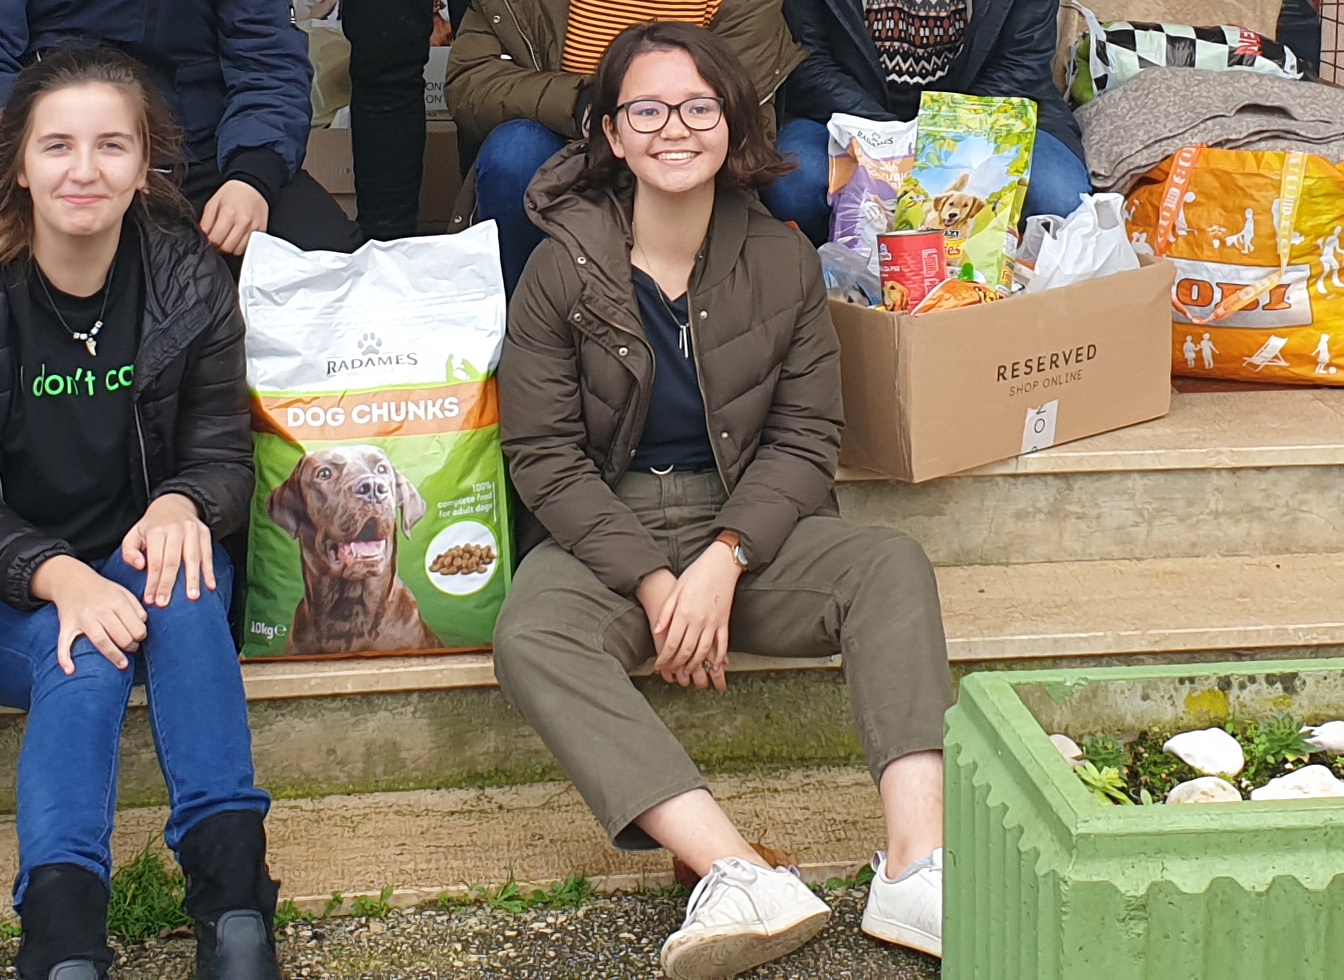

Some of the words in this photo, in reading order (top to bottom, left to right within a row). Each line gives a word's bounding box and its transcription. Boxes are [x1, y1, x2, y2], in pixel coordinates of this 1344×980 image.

[326, 352, 418, 376] RADAMES
[996, 343, 1097, 383] RESERVED
[32, 363, 96, 397] don't
[1009, 380, 1039, 397] SHOP
[1042, 369, 1084, 389] ONLINE
[287, 406, 346, 427] DOG
[351, 396, 461, 425] CHUNKS
[437, 496, 476, 508] complete
[439, 510, 451, 518] for
[452, 506, 475, 516] adult
[251, 620, 274, 640] 10kg
